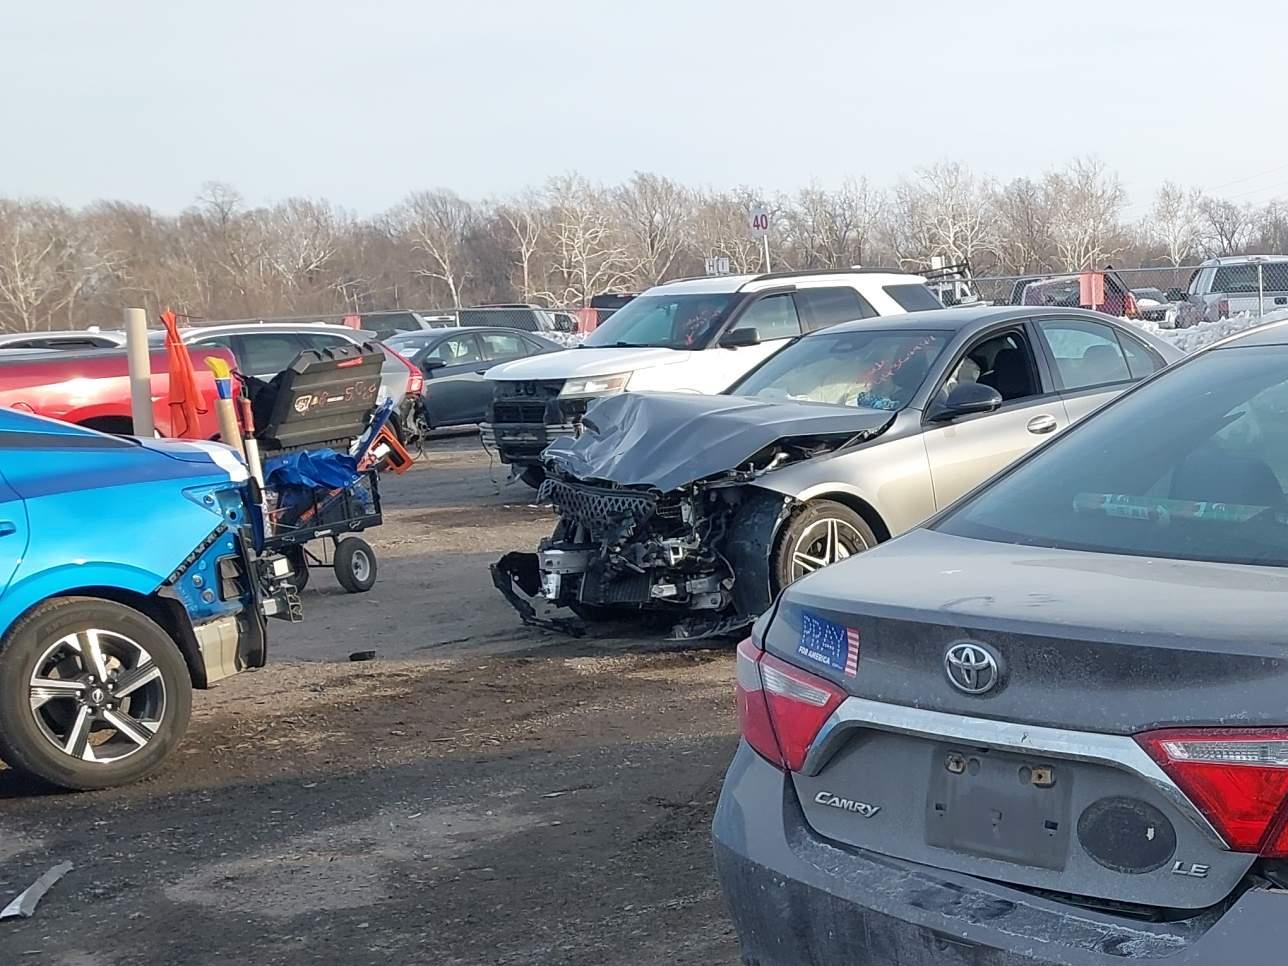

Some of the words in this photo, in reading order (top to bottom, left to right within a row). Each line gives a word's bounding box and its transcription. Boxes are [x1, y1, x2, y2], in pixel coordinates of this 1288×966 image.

[753, 214, 768, 230] 40
[802, 614, 845, 658] PRAY
[799, 645, 809, 656] FOR
[808, 650, 831, 665] AMERICA
[815, 791, 881, 818] CAMRY
[1171, 861, 1210, 878] LE
